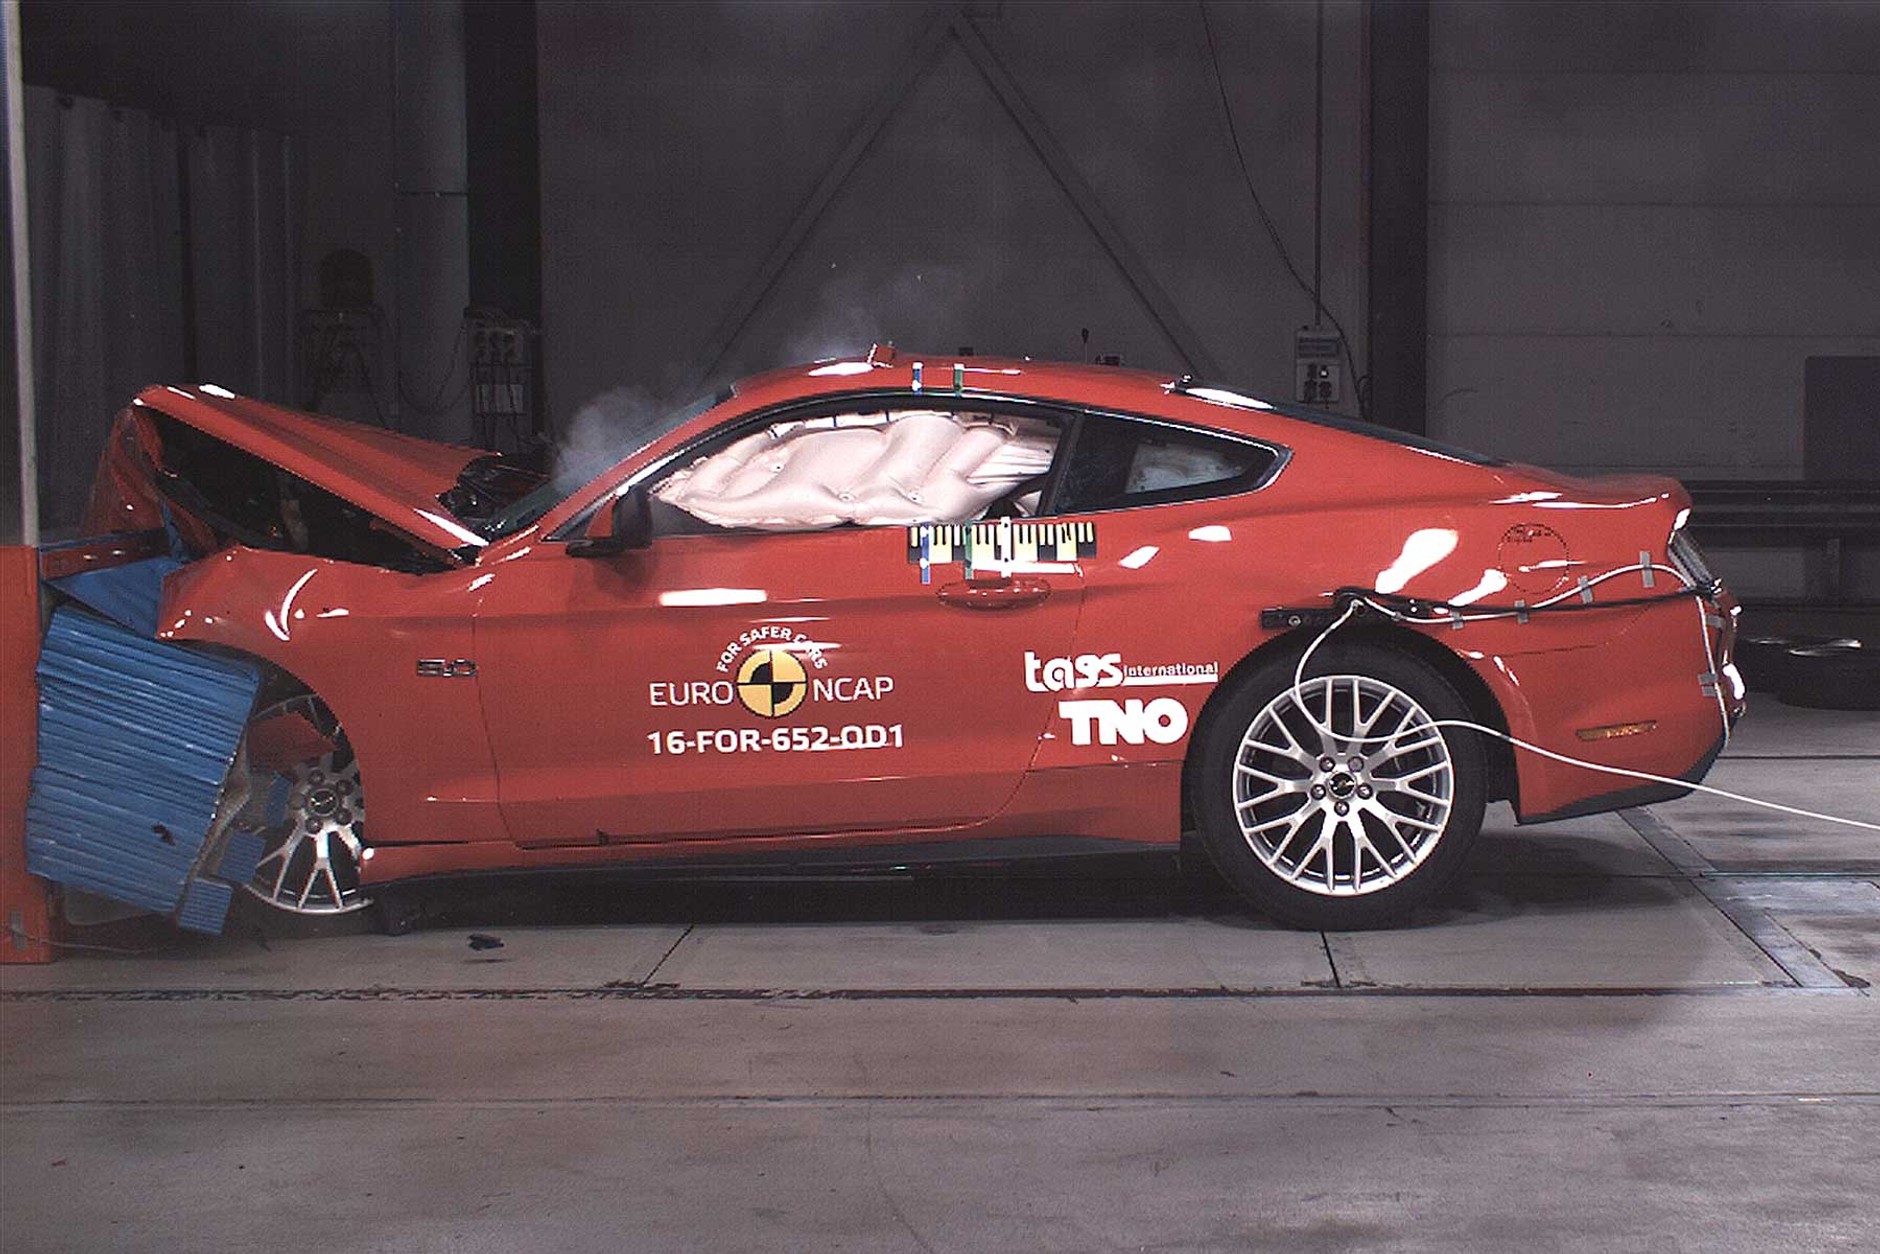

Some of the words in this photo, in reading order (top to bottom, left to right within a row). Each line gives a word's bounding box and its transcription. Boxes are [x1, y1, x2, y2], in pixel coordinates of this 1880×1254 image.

[416, 658, 478, 677] 5.0
[716, 641, 743, 673] FOR
[739, 625, 793, 647] SAFER
[792, 633, 828, 669] CARS
[649, 680, 735, 706] EURO
[812, 676, 895, 702] NCAP
[1023, 650, 1124, 692] tass
[1123, 661, 1219, 677] international
[1057, 697, 1189, 746] TNO
